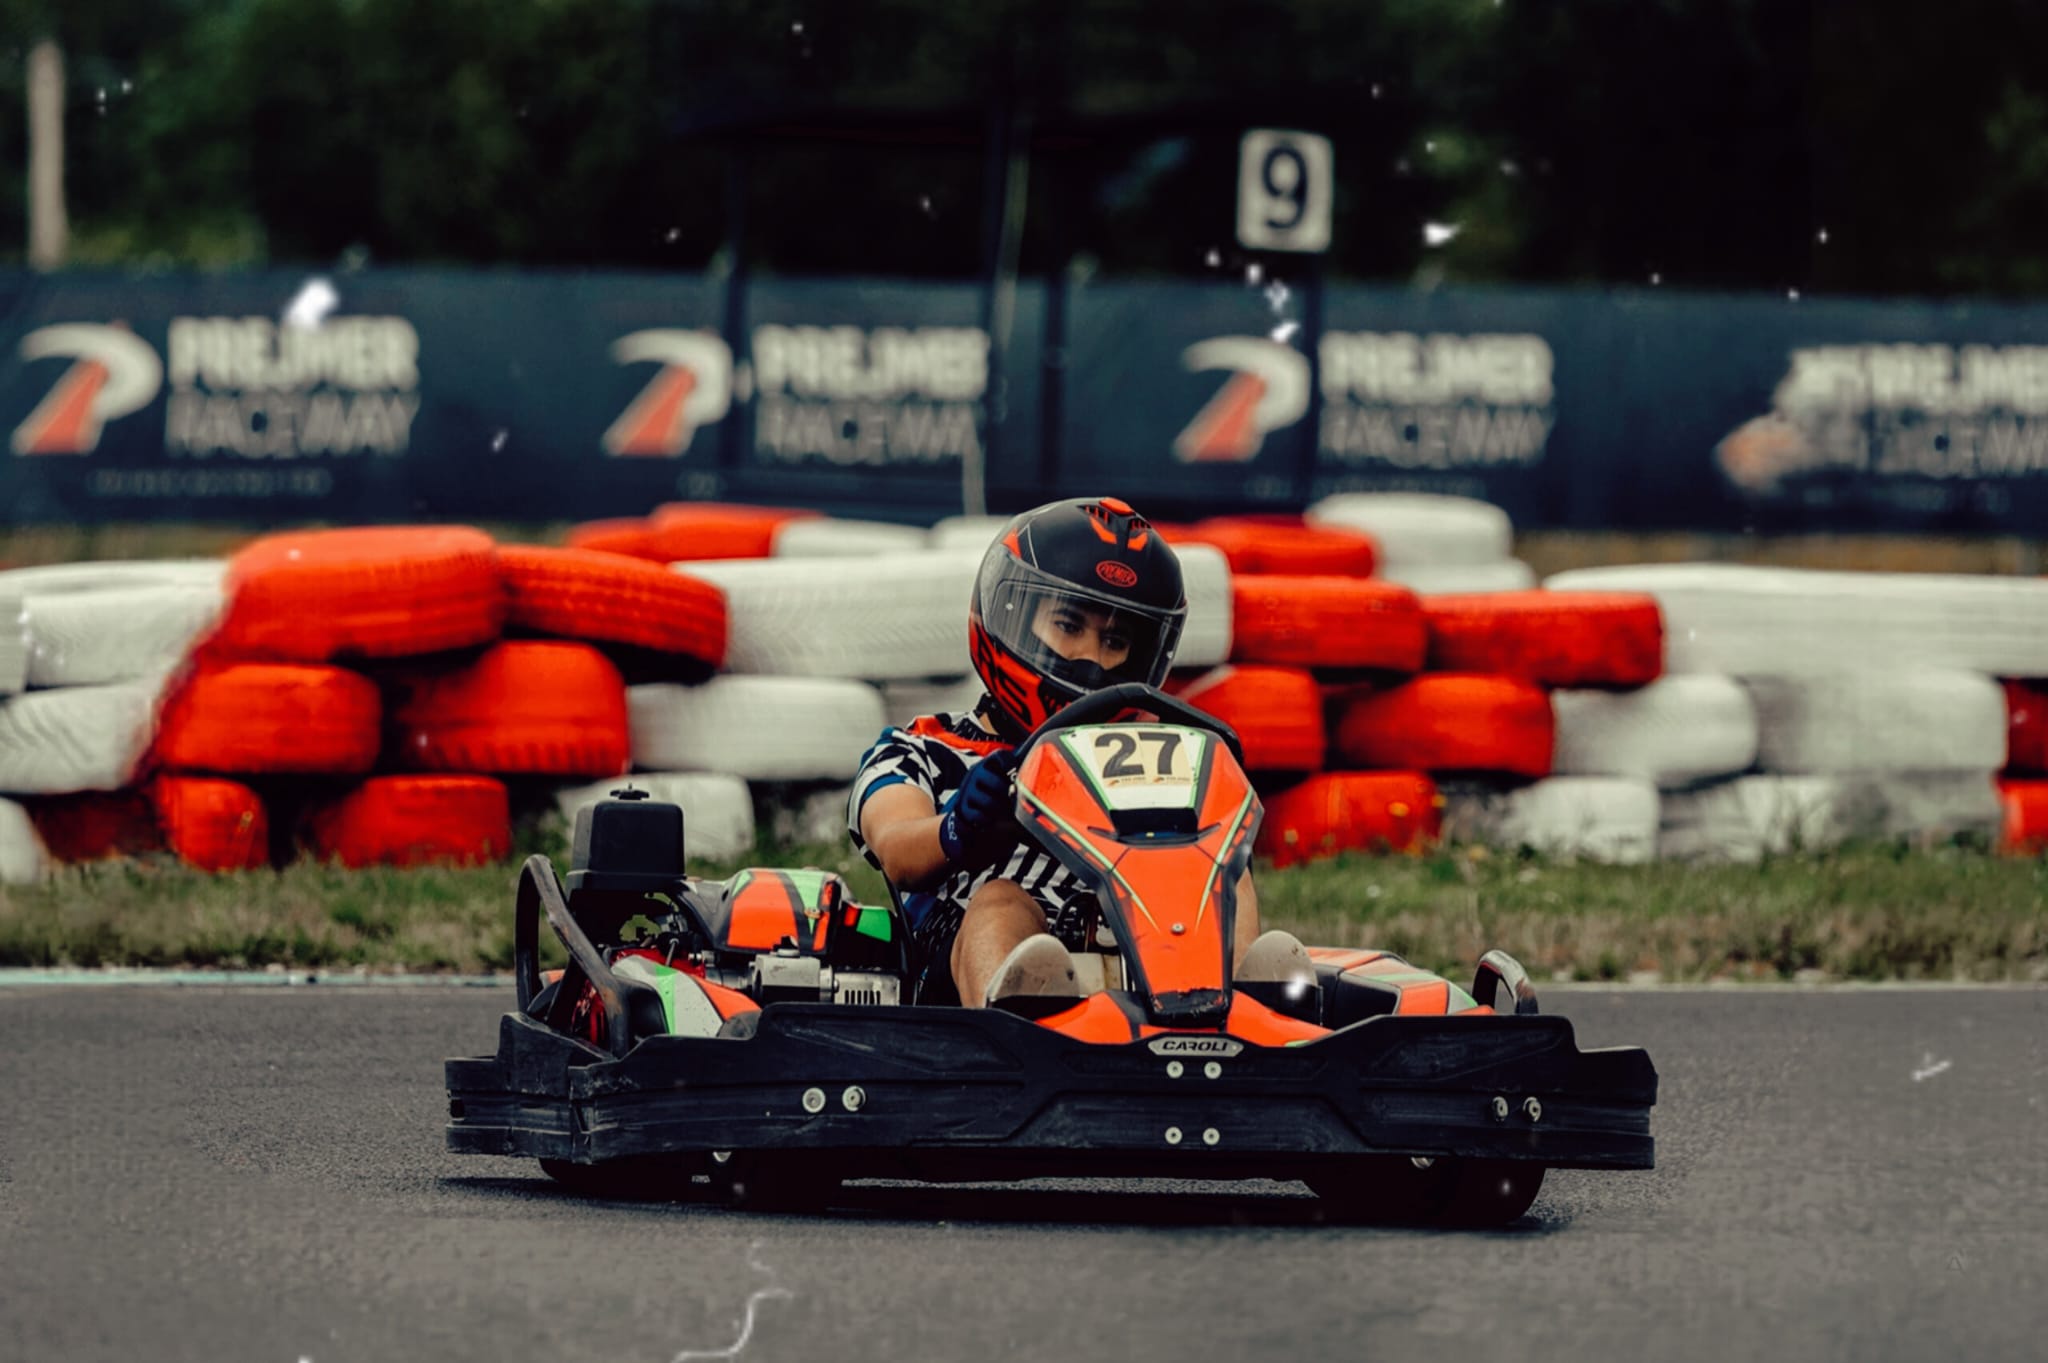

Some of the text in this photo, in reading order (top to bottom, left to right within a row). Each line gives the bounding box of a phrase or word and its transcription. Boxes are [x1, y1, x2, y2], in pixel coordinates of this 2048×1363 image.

[1261, 144, 1308, 229] 9
[168, 316, 419, 391] PREJMER
[1319, 331, 1554, 404] PREJMER
[165, 391, 419, 458] RACEWAY
[1318, 402, 1555, 468] RACEWAY
[1095, 731, 1182, 778] 27
[1162, 1041, 1228, 1052] CAROLI
